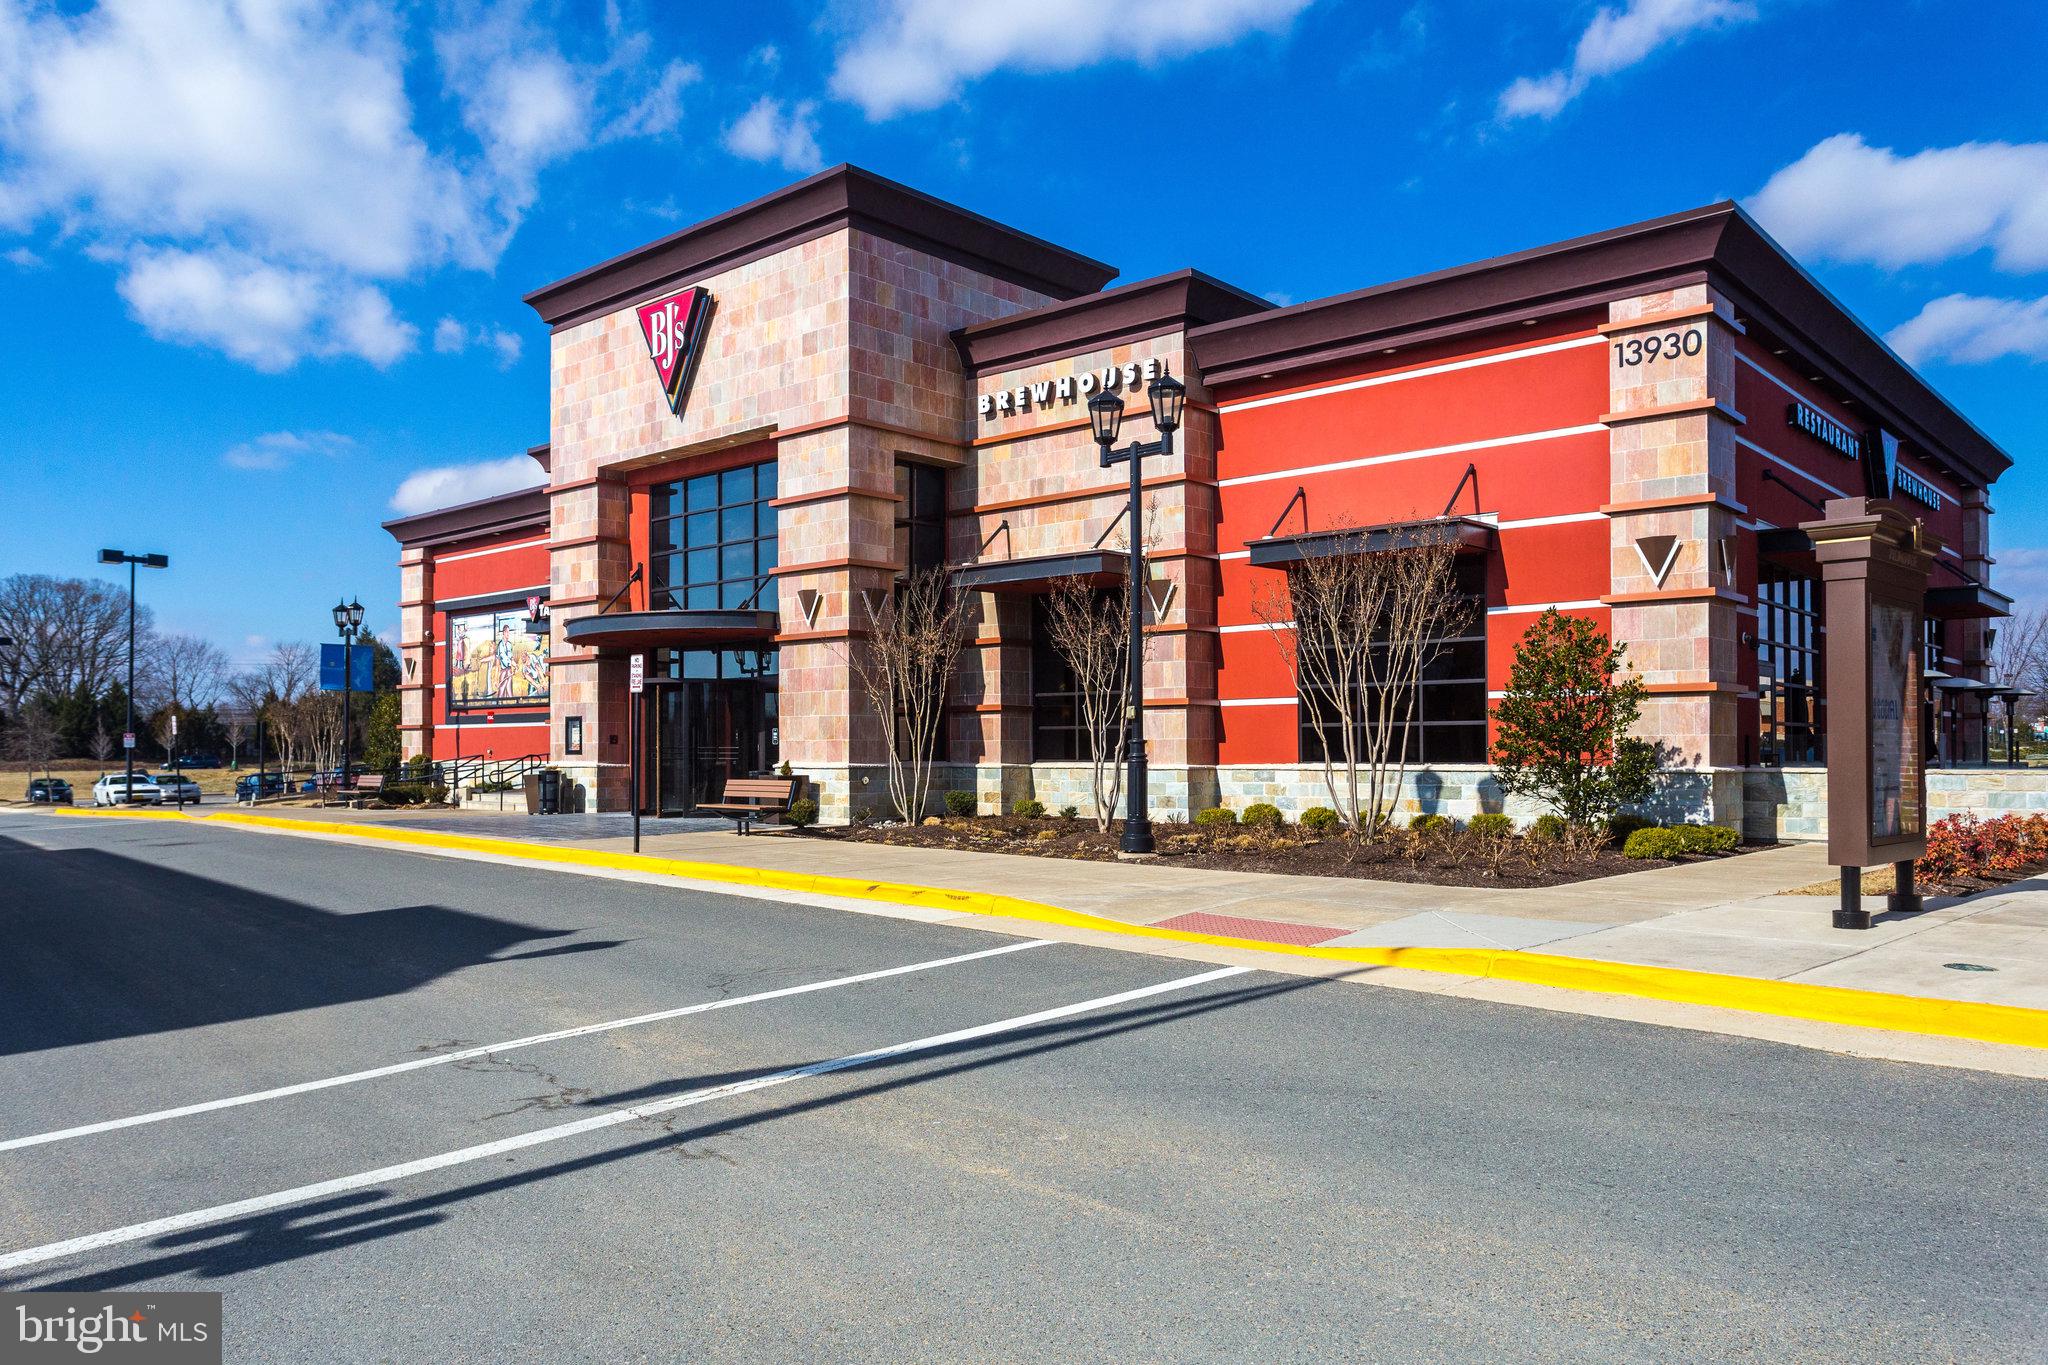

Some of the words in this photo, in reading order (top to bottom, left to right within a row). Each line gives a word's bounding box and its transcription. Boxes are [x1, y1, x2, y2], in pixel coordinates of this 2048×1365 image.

[650, 301, 685, 370] BJ's
[1613, 329, 1703, 368] 13930
[978, 357, 1158, 415] BREWHOUSE
[1797, 402, 1860, 461] RESTAURANT
[1897, 468, 1941, 511] BREWHOUSE
[539, 603, 551, 617] TA
